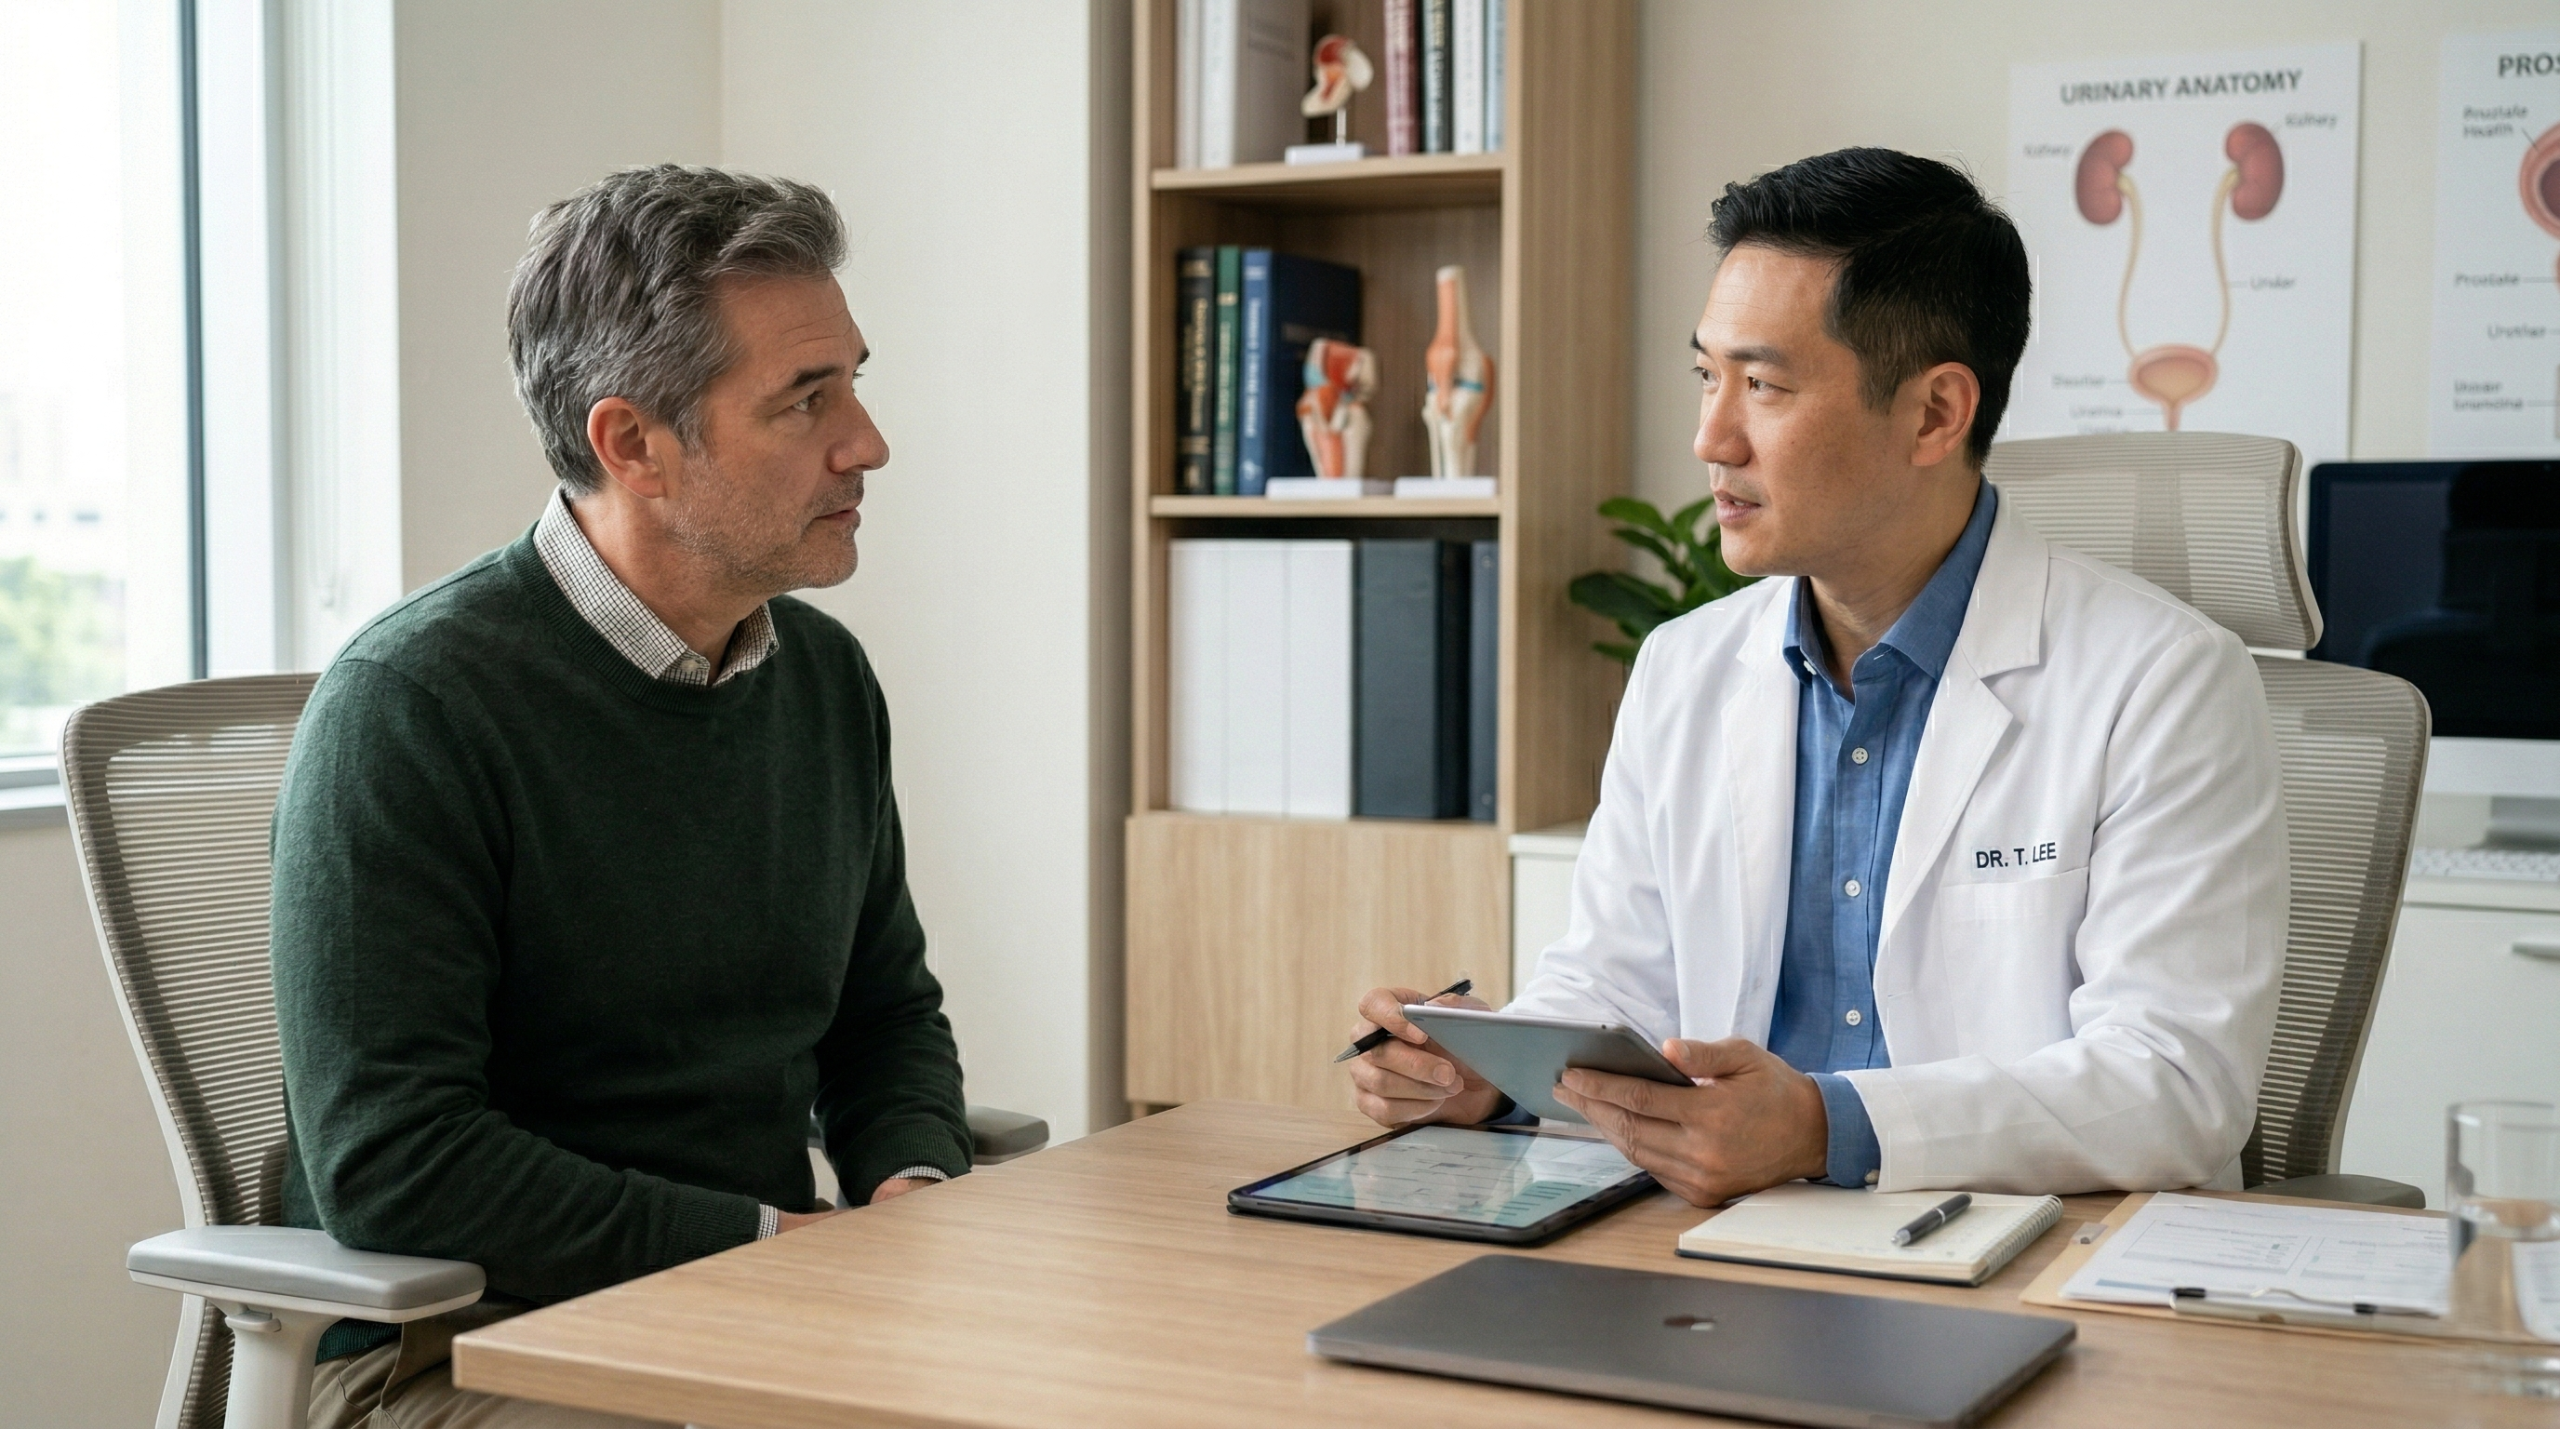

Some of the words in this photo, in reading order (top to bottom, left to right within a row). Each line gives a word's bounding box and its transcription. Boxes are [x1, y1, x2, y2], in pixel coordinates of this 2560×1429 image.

[2060, 78, 2168, 105] URINARY
[2175, 69, 2302, 97] ANATOMY
[1976, 850, 2008, 868] DR.
[2013, 848, 2028, 865] T.
[2032, 842, 2057, 863] LEE
